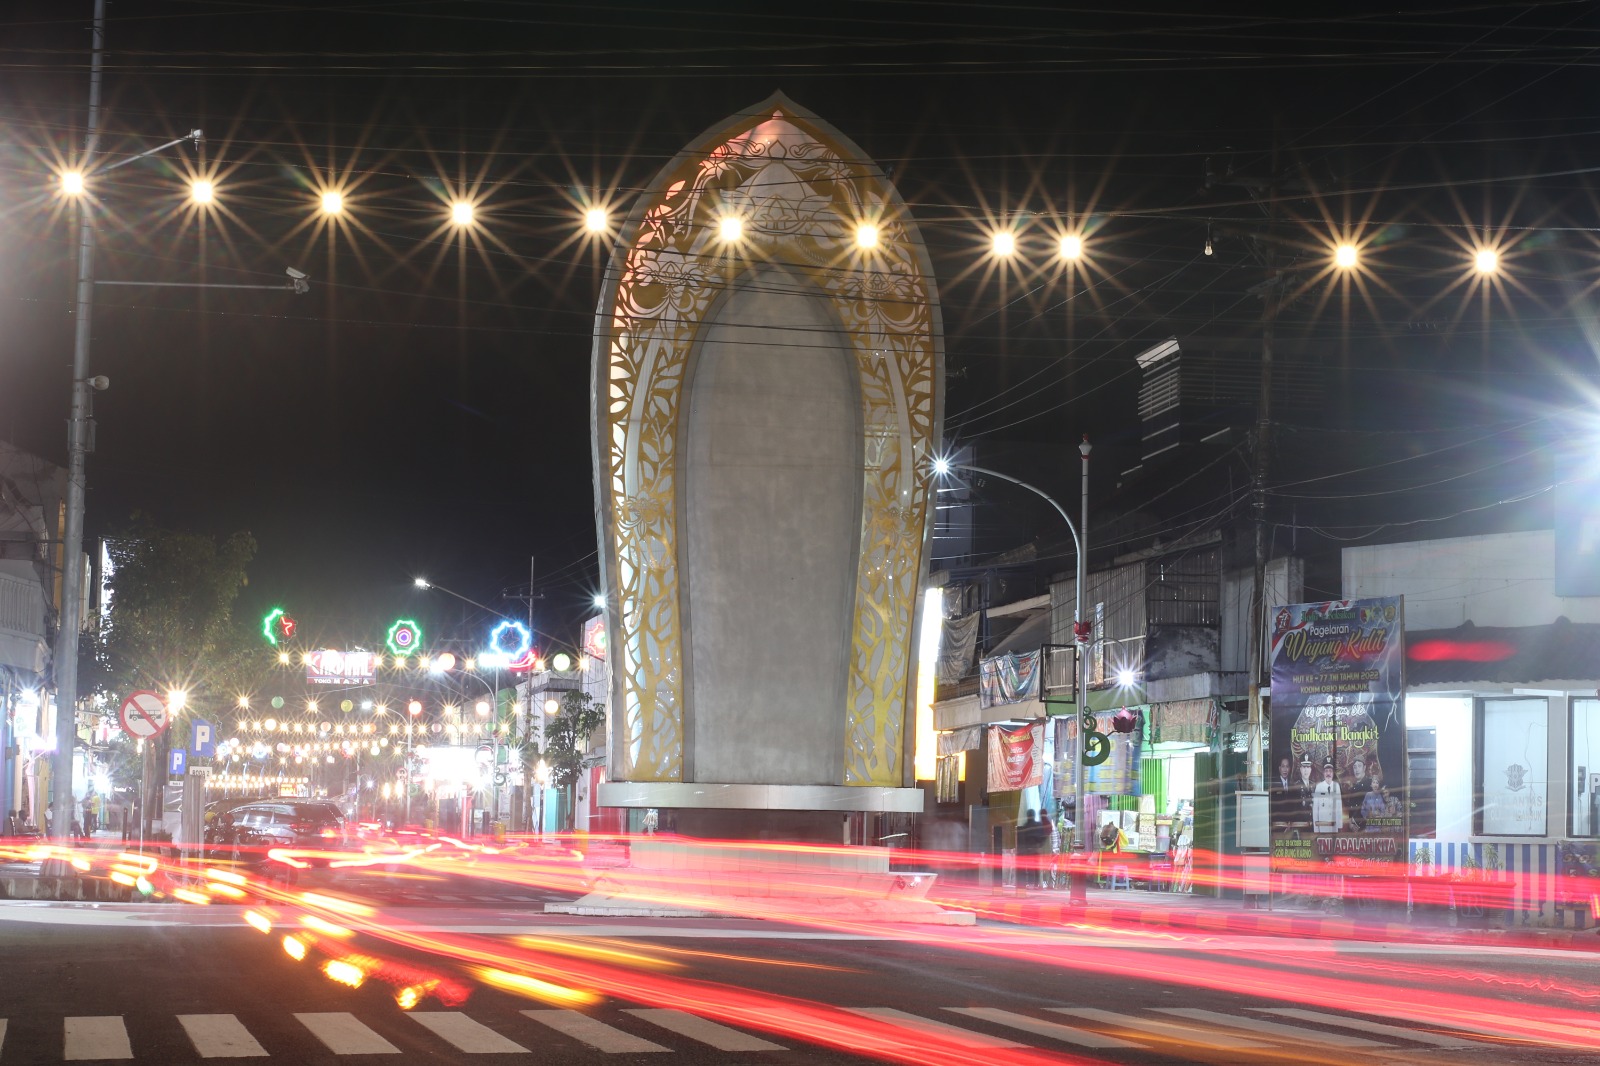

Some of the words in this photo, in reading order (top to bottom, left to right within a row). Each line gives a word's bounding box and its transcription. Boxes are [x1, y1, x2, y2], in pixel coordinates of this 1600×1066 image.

[1310, 625, 1349, 638] Pagelaran
[1285, 629, 1344, 664] Wayang
[1346, 627, 1386, 659] Kulit
[1292, 674, 1304, 684] HUT
[1306, 674, 1314, 683] KE
[1320, 674, 1328, 683] 77
[1329, 673, 1339, 682] TNI
[1340, 672, 1360, 682] TAHUN
[1361, 670, 1379, 680] 2022
[1301, 685, 1320, 695] KODIM
[1322, 683, 1337, 693] 0810
[1338, 682, 1368, 692] NGANJUK
[195, 725, 210, 751] P
[1341, 724, 1379, 748] Bangkit
[172, 752, 183, 770] P
[1316, 837, 1333, 854] TNI
[1334, 837, 1373, 854] ADALAH
[1373, 837, 1397, 854] KITA
